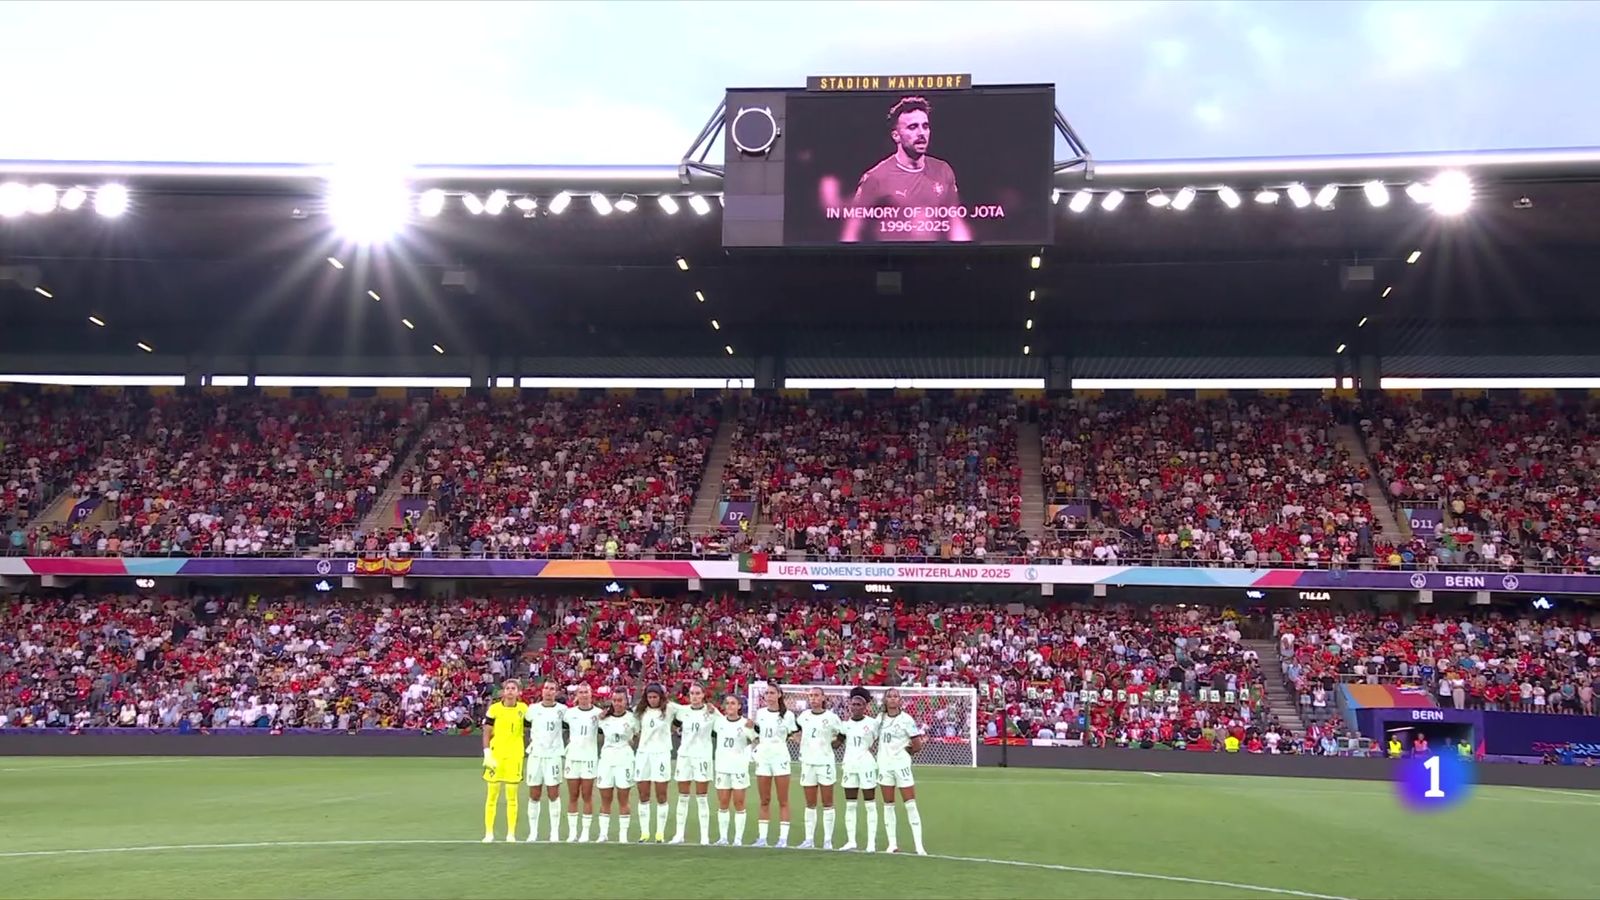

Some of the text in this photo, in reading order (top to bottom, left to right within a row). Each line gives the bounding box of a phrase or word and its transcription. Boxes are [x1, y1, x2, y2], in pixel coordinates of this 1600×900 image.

[820, 75, 963, 90] STADION WANKDORF
[826, 205, 1005, 219] IN MEMORY OF DIOGO JOTA
[880, 220, 950, 232] 1996-2025
[1411, 519, 1434, 529] D11
[778, 565, 1011, 580] UEFA WOMEN'S EURO SWITZERLAND 2025
[1445, 575, 1486, 588] BERN
[1412, 710, 1444, 721] BERN
[580, 724, 588, 736] 11
[691, 722, 701, 733] 19
[811, 727, 817, 739] 2
[724, 736, 735, 749] 20
[853, 735, 862, 748] 17
[699, 761, 709, 773] 19
